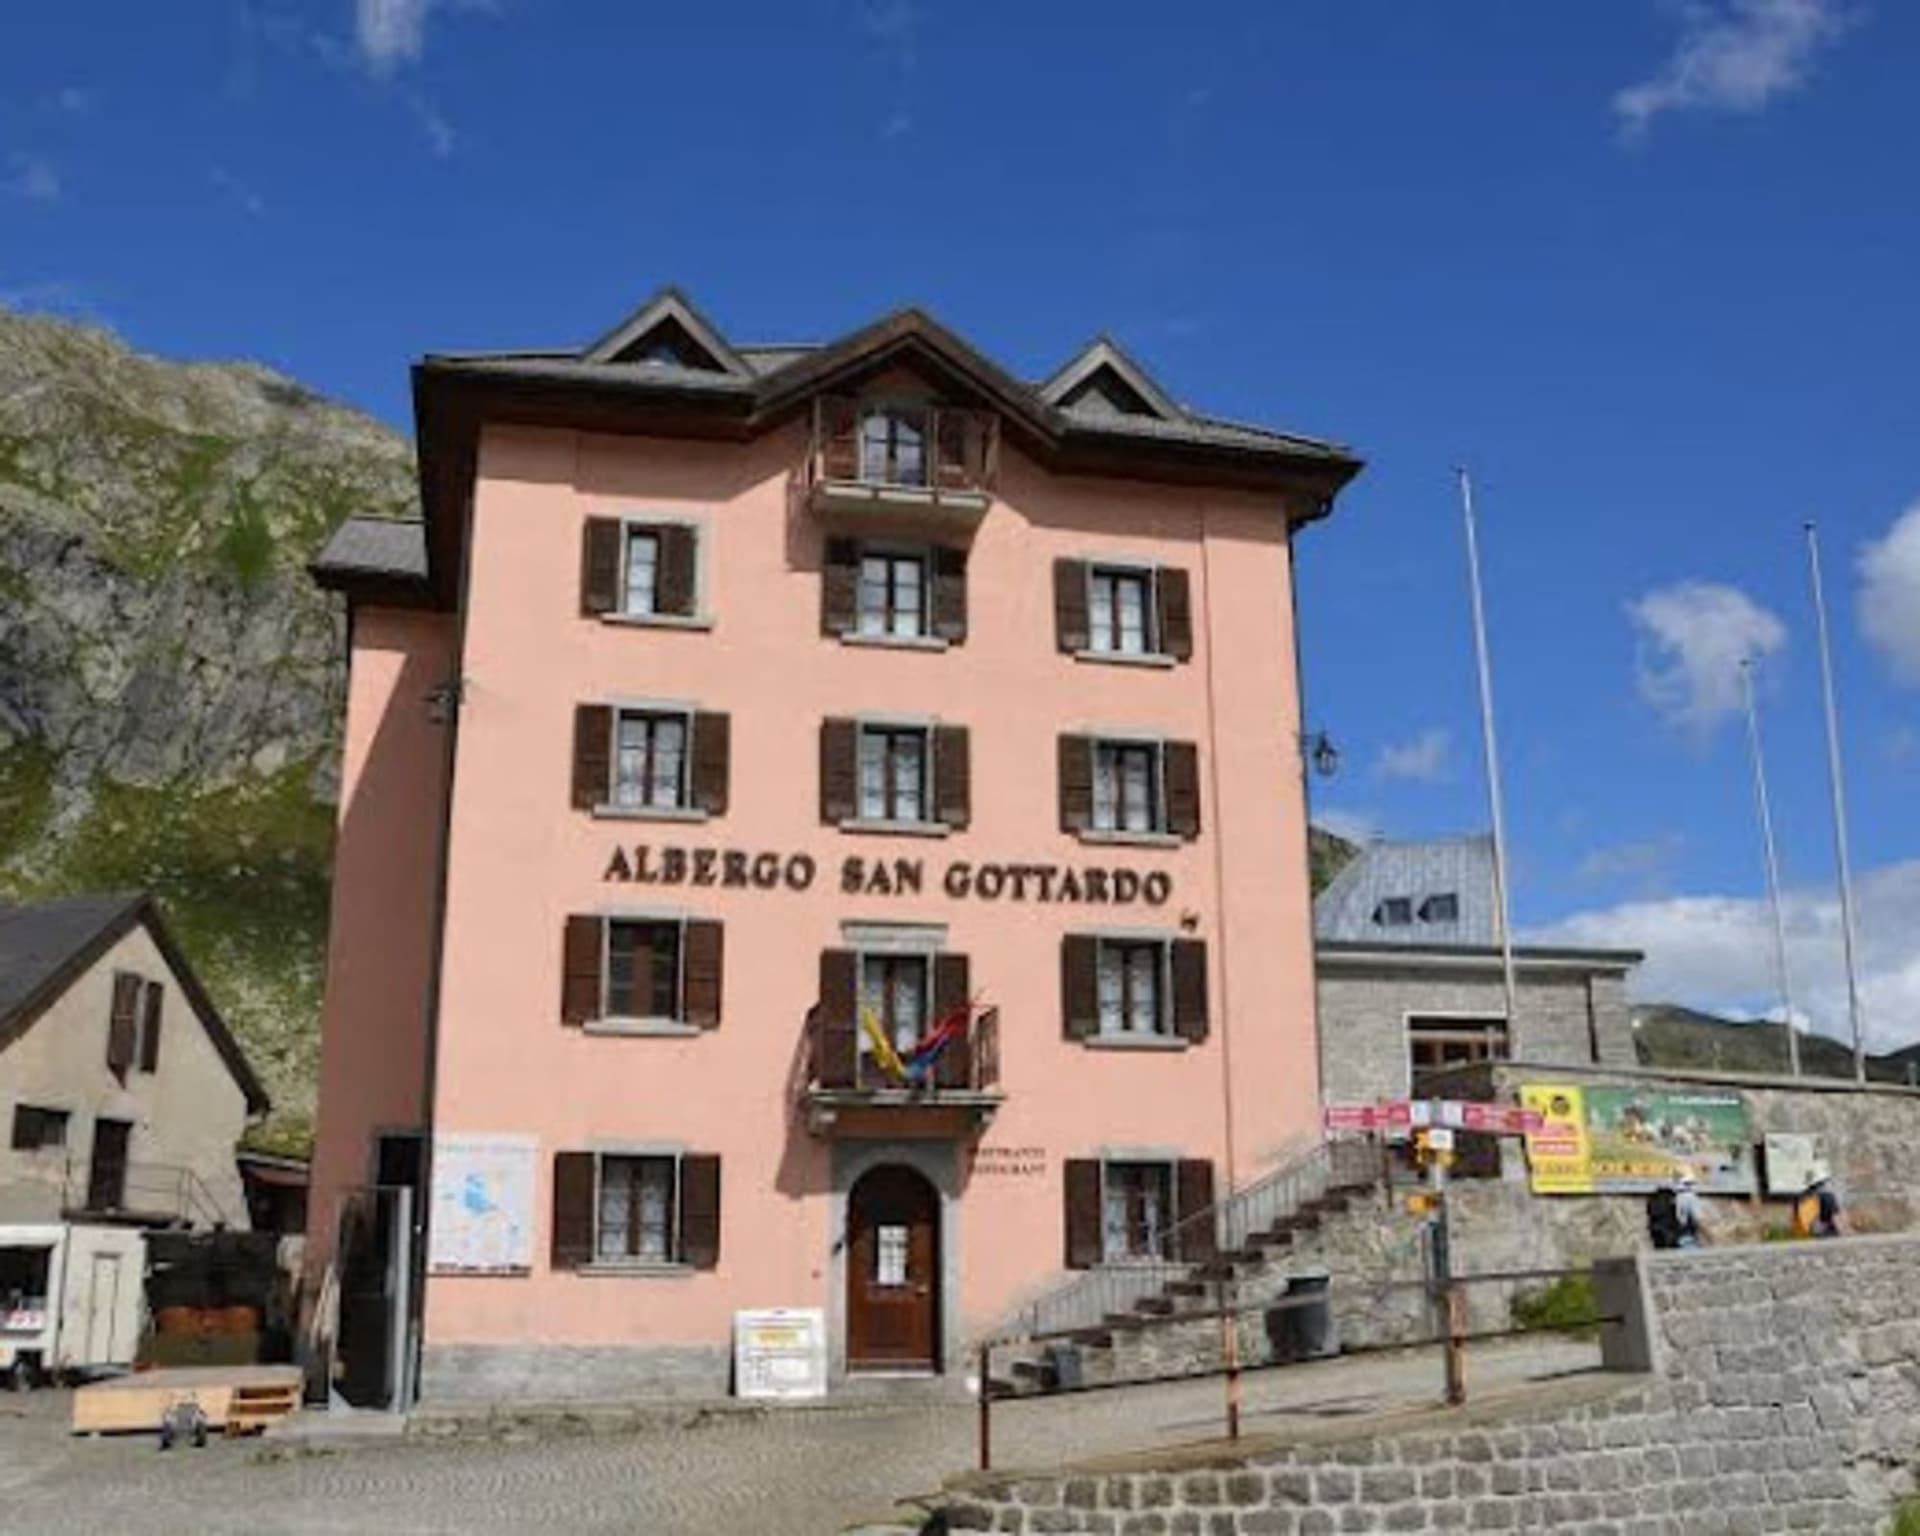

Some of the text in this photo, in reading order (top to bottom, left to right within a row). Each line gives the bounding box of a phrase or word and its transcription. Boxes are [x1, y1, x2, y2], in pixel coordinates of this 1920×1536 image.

[603, 845, 1172, 905] ALBERGO SAN GOTTARDO
